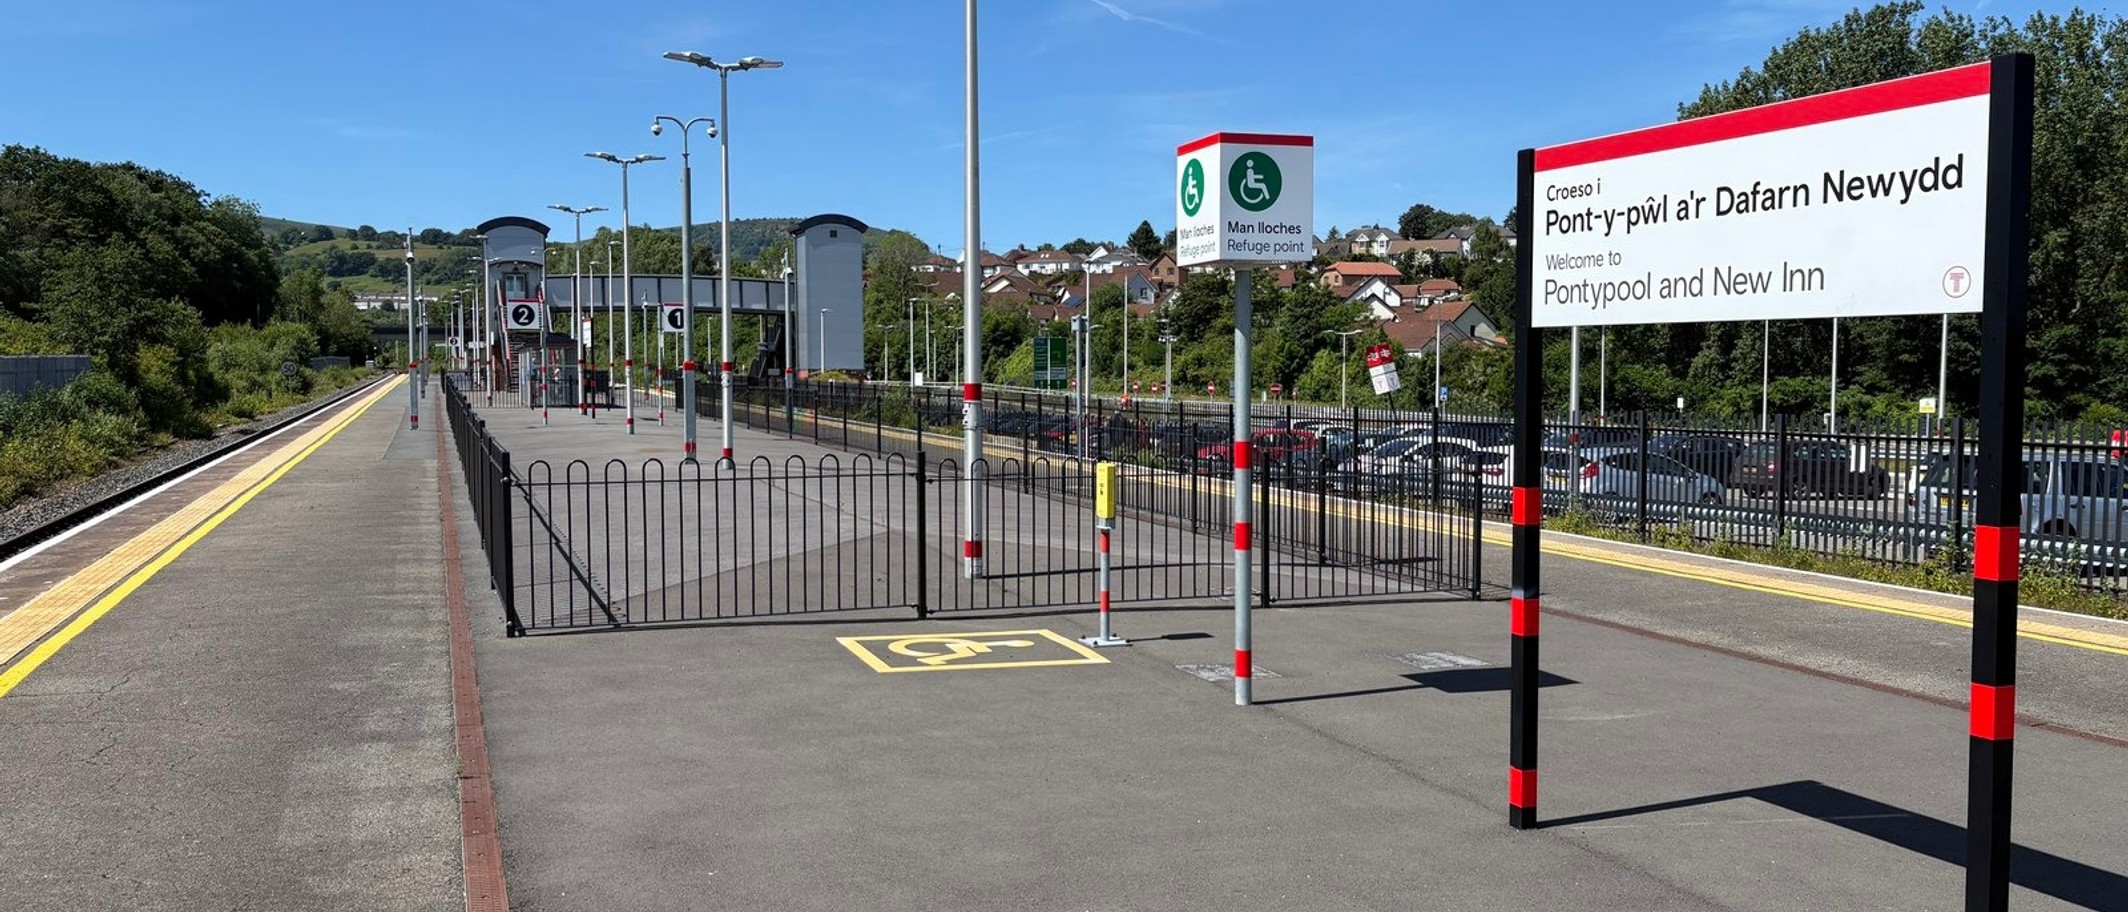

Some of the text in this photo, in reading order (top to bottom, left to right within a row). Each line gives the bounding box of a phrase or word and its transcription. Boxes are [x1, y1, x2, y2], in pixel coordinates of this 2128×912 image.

[1545, 152, 1964, 238] Pont-y-pŵl a'r Dafarn Newydd
[1546, 177, 1601, 202] Croeso i
[1179, 228, 1193, 241] Man
[1227, 220, 1302, 235] Man lloches
[1227, 238, 1305, 255] Refuge point
[1545, 250, 1622, 271] Welcome to
[1544, 261, 1825, 311] Pontypool and New Inn
[518, 307, 529, 323] 2
[674, 311, 681, 327] 1
